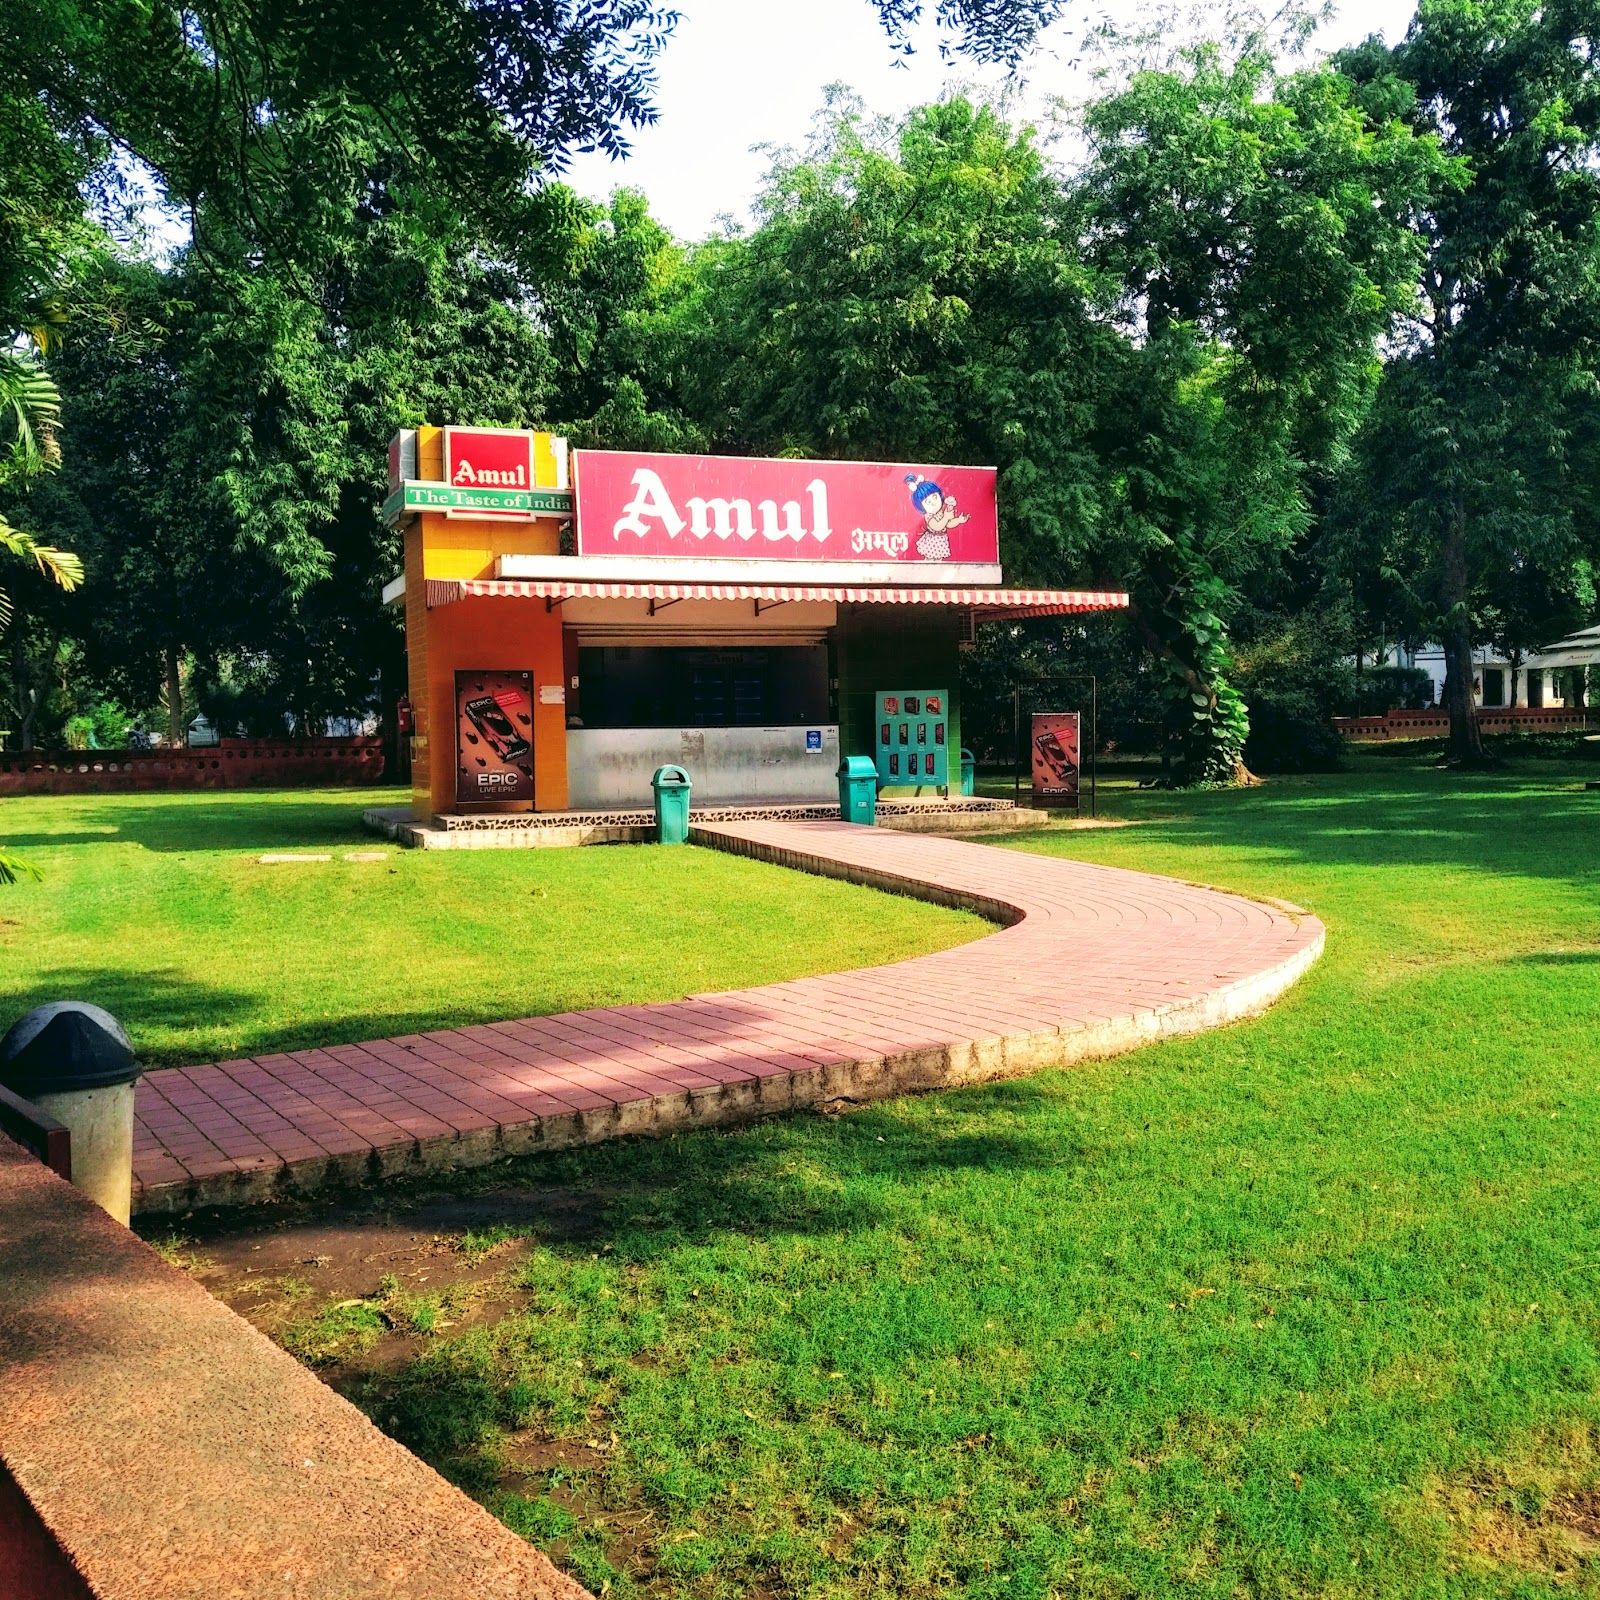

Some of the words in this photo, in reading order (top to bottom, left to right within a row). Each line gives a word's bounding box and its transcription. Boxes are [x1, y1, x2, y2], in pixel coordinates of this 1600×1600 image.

[453, 459, 526, 486] Amul
[410, 489, 449, 504] The
[451, 491, 500, 506] Taste
[504, 495, 525, 508] of
[525, 495, 571, 511] India
[613, 468, 833, 543] Amul
[851, 527, 909, 558] अमूल
[470, 699, 493, 708] EPIC
[477, 773, 518, 786] EPIC
